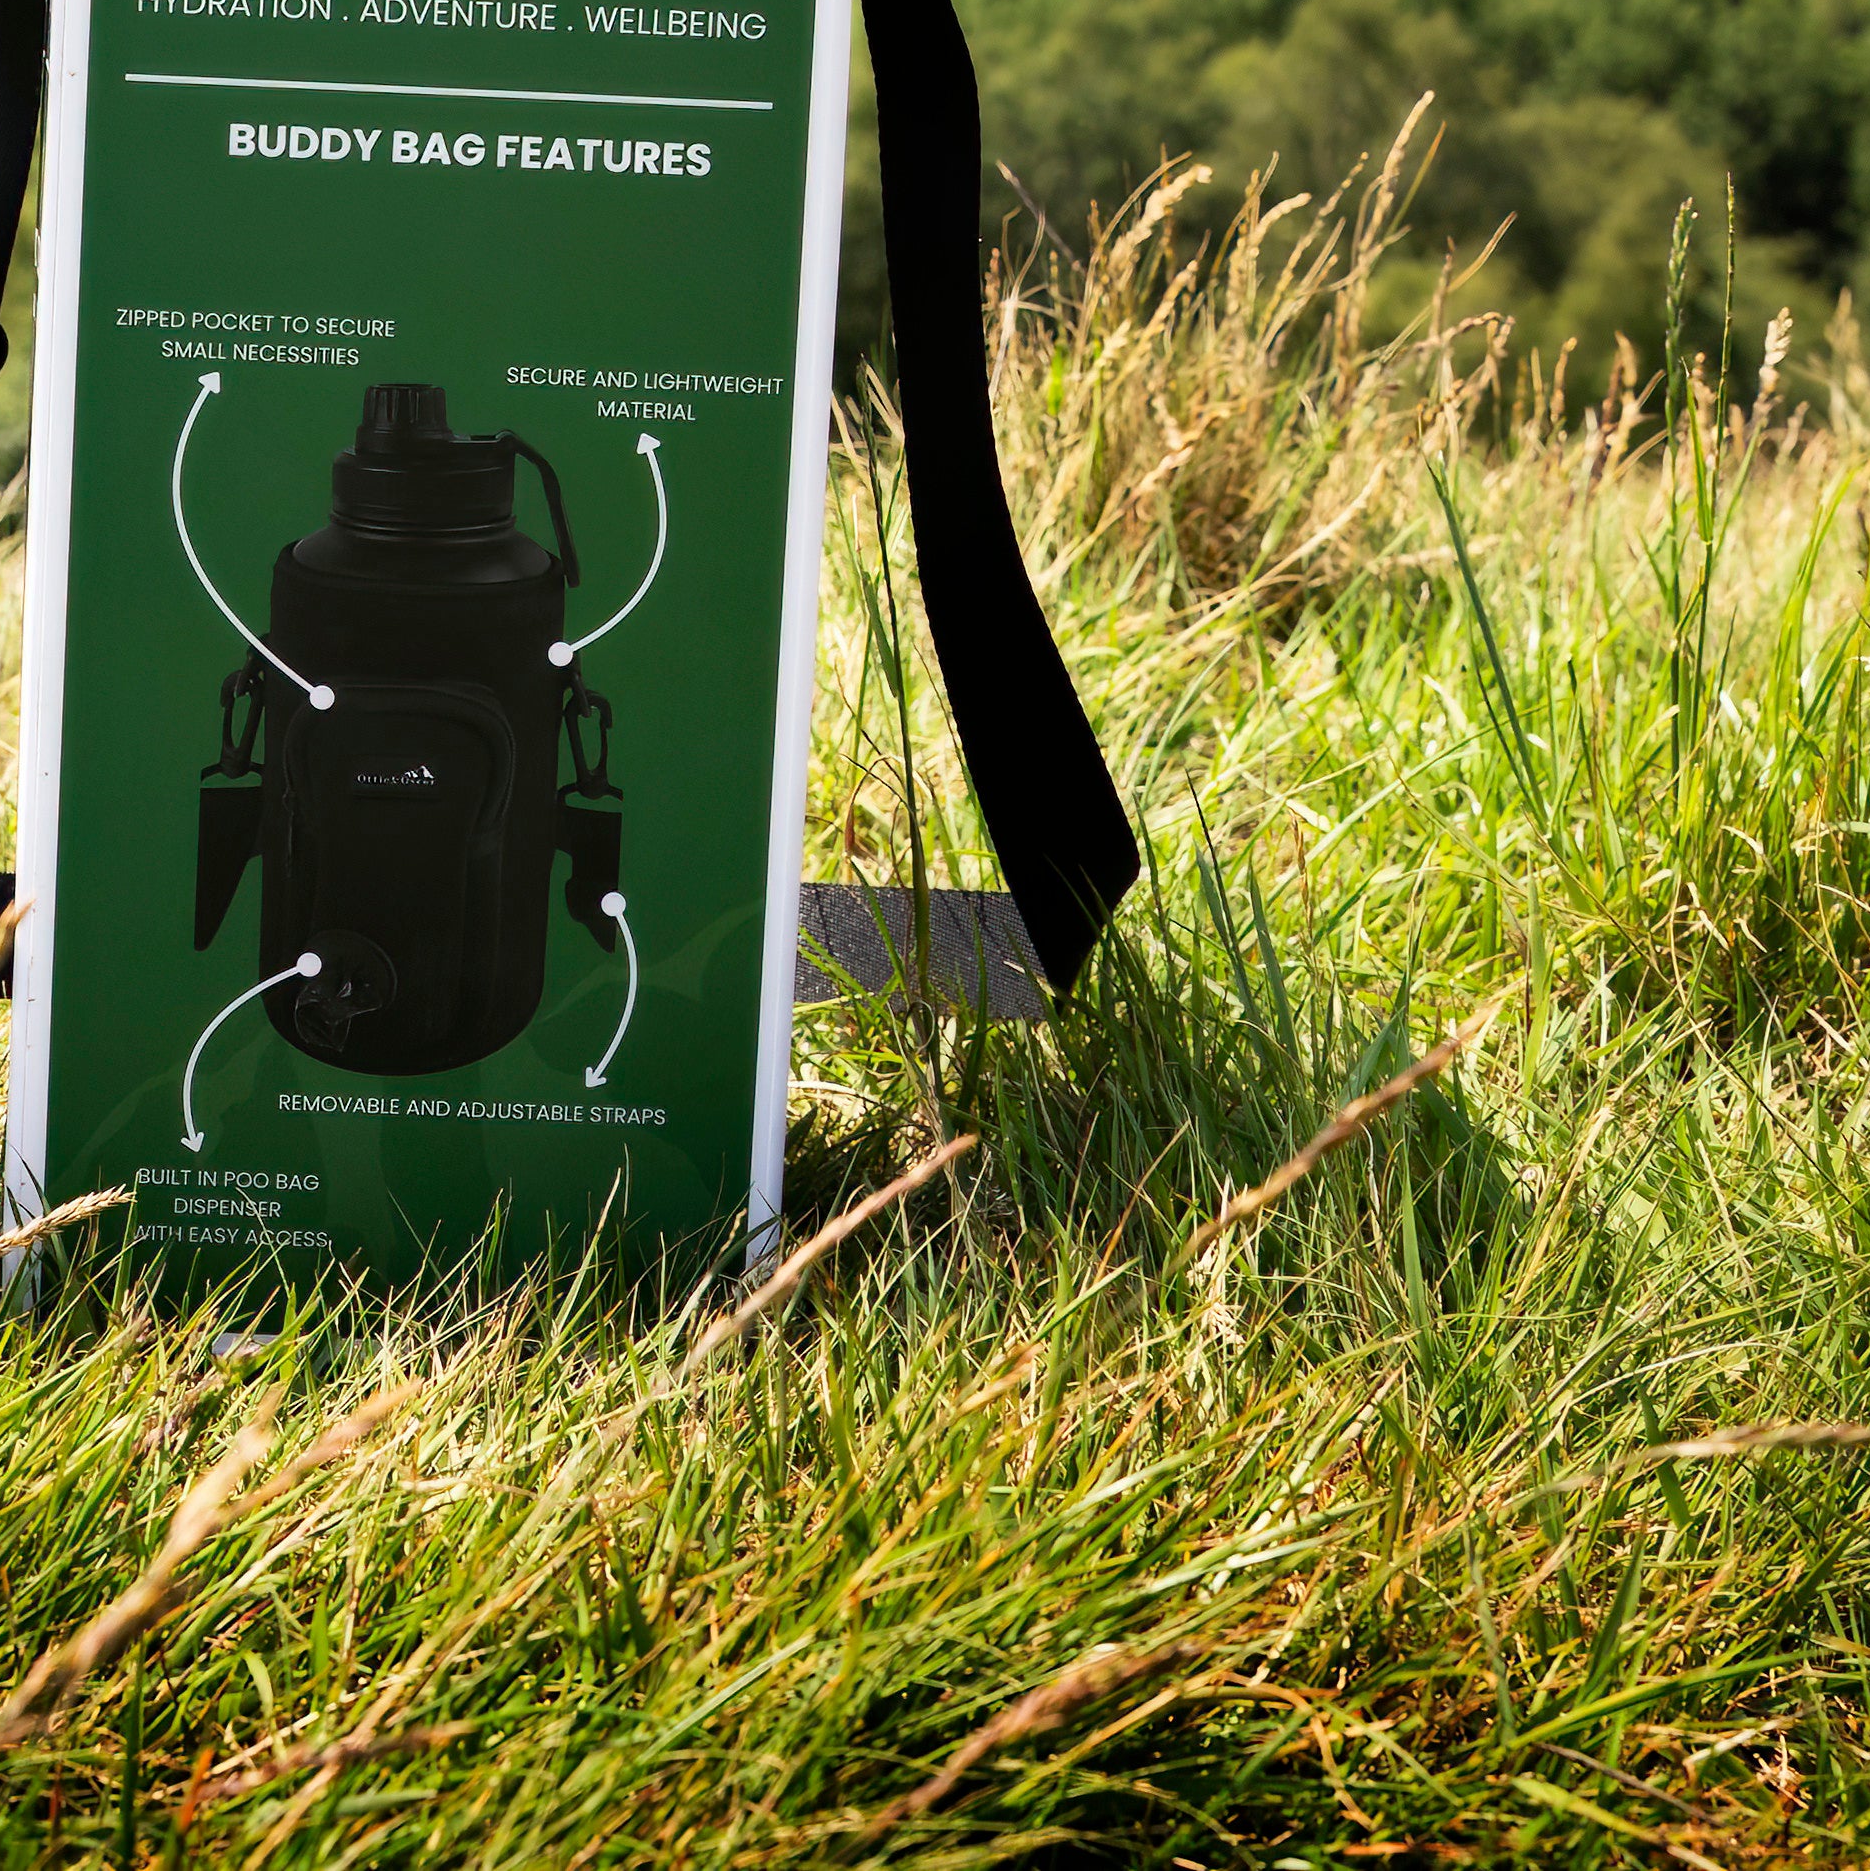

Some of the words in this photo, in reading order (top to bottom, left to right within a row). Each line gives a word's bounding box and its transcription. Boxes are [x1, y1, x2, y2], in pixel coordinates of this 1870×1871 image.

[585, 5, 767, 40] WELLBEING
[228, 123, 383, 162] BUDDY
[391, 130, 486, 167] BAG
[496, 134, 711, 177] FEATURES
[116, 308, 186, 328] ZIPPED
[191, 311, 275, 332] POCKET
[280, 315, 310, 334] TO
[315, 317, 396, 338] SECURE
[161, 339, 227, 360] SMALL
[232, 343, 359, 366] NECESSITIES
[506, 366, 587, 387] SECURE
[592, 370, 638, 389] AND
[643, 372, 784, 395] LIGHTWEIGHT
[597, 400, 696, 421] MATERIAL
[279, 1094, 400, 1115] REMOVABLE
[406, 1099, 451, 1117] AND
[456, 1101, 584, 1122] ADJUSTABLE
[589, 1106, 666, 1126] STRAPS
[137, 1167, 192, 1186] BUILT
[197, 1170, 217, 1187] IN
[224, 1171, 270, 1190] POO
[275, 1173, 320, 1191] BAG
[173, 1197, 281, 1218] DISPENSER
[188, 1226, 240, 1244] EASY
[244, 1228, 328, 1248] ACCESS
